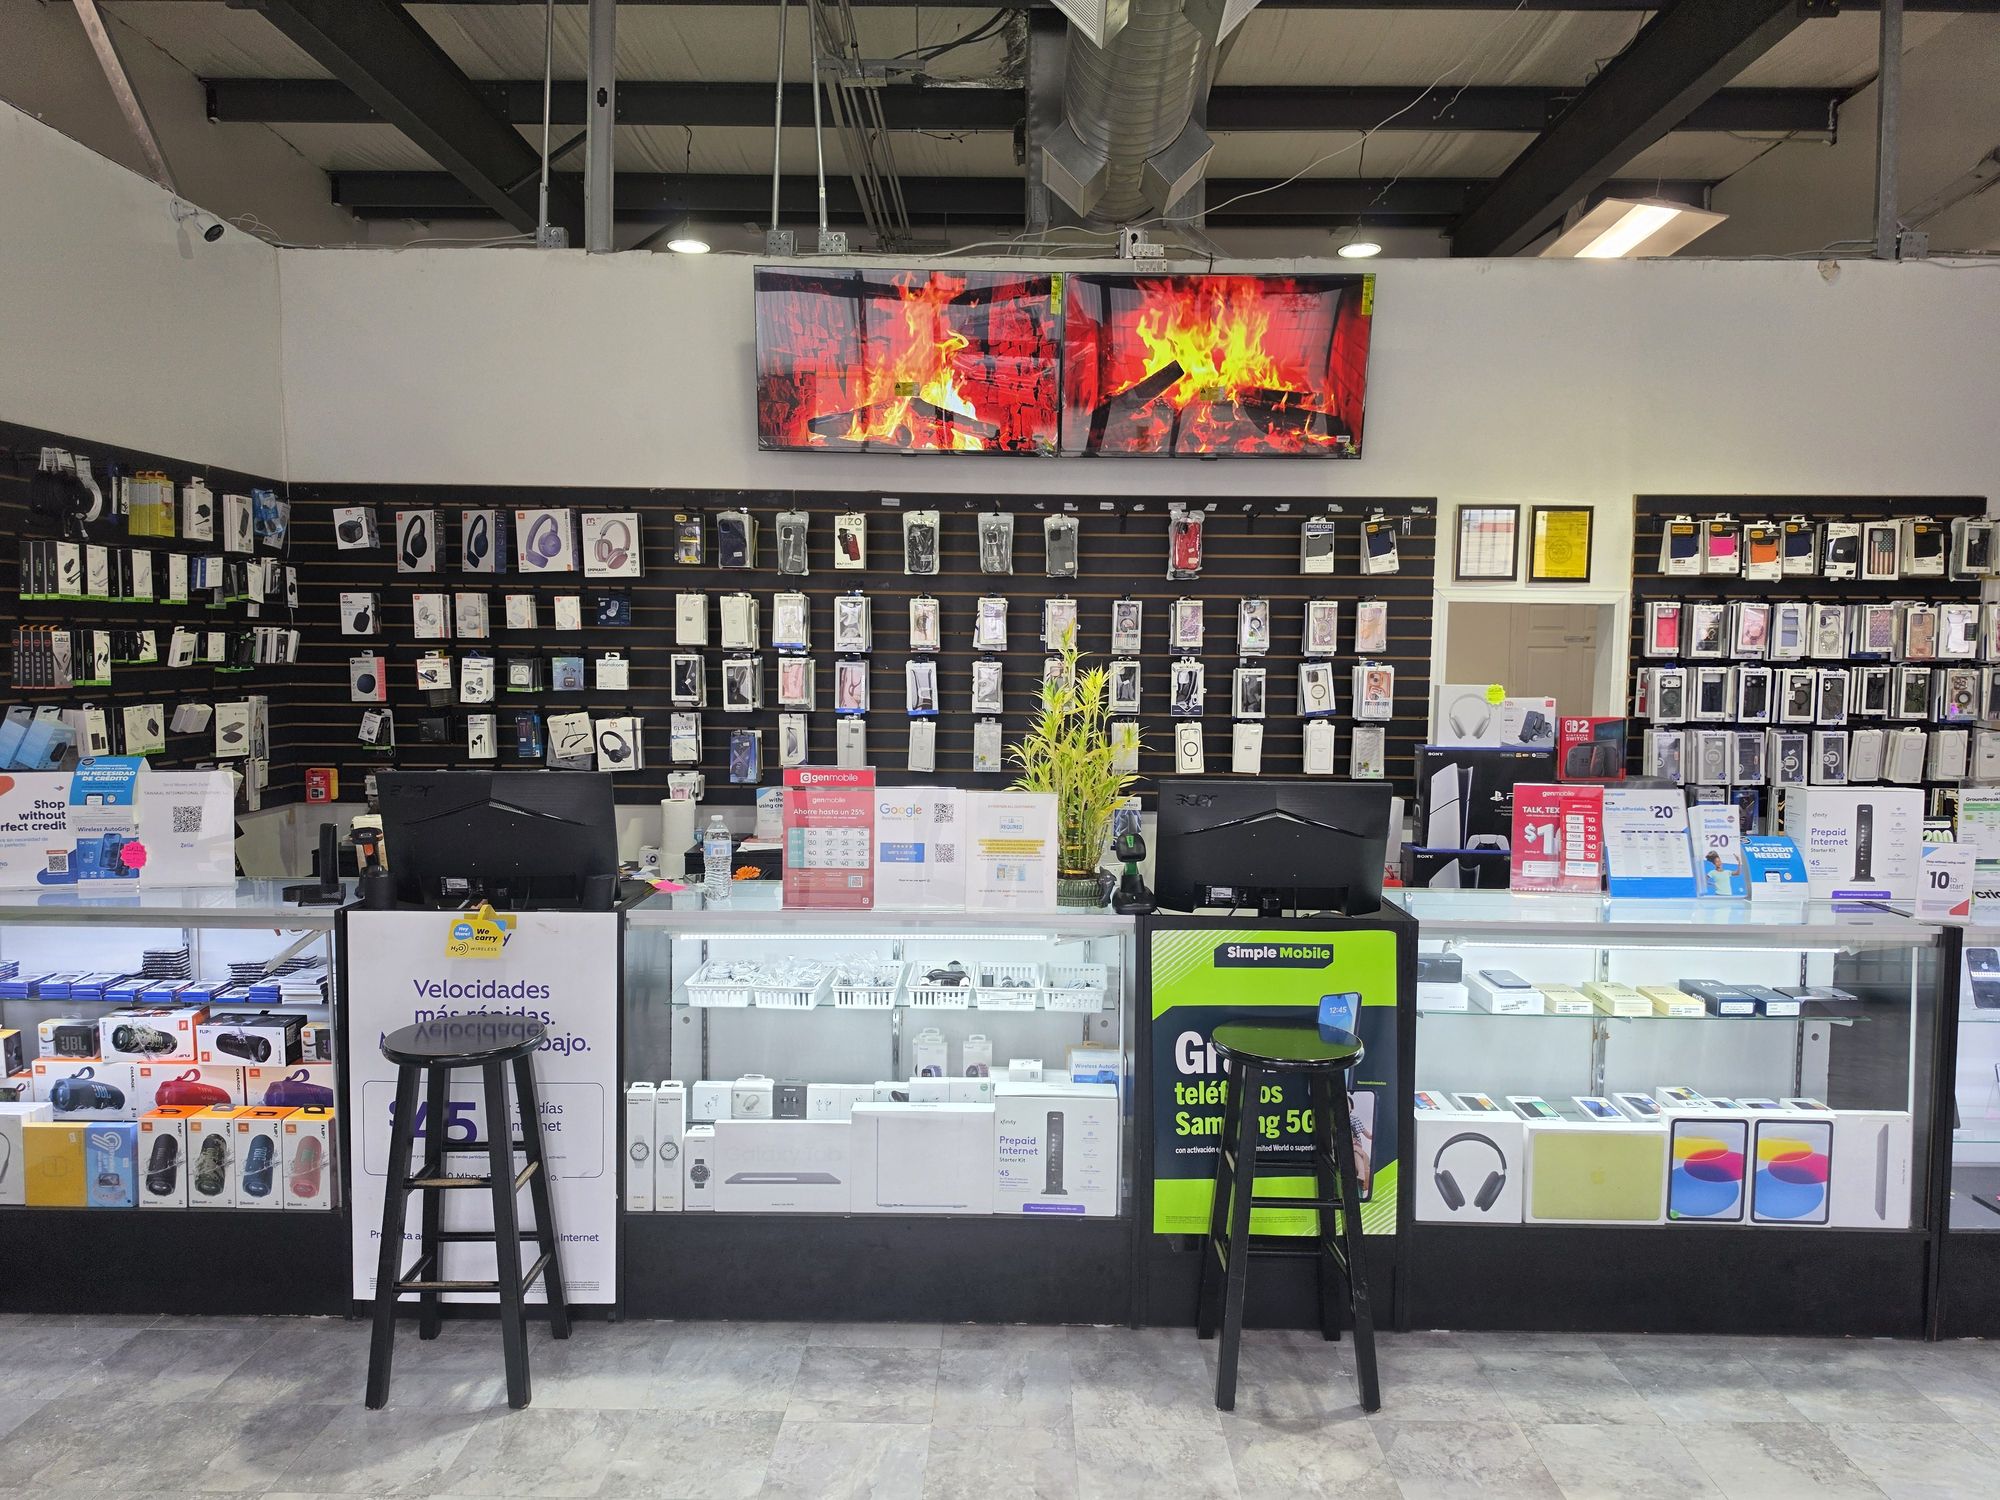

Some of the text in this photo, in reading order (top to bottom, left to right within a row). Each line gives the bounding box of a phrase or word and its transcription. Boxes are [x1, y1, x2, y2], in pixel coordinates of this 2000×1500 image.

[838, 518, 862, 526] ZIZO
[812, 773, 858, 783] genmobile
[34, 800, 66, 812] Shop
[880, 802, 922, 817] Google
[1522, 806, 1544, 814] TALK,
[19, 811, 66, 821] without
[794, 808, 817, 816] Ahorre
[819, 808, 839, 816] hasta
[850, 808, 865, 816] 25%
[1650, 805, 1673, 818] $20
[32, 821, 67, 831] credit
[1811, 827, 1847, 838] Prepaid
[1705, 834, 1729, 848] $20
[1811, 838, 1848, 846] Internet
[1927, 870, 1949, 889] $10
[475, 935, 498, 943] carry
[1227, 945, 1331, 961] Simple Mobile
[413, 979, 550, 999] Velocidades
[1329, 1006, 1347, 1014] 12:45
[63, 1036, 87, 1051] JBL
[1175, 1111, 1280, 1138] Samng
[999, 1135, 1036, 1147] Prepaid
[999, 1146, 1038, 1155] Internet
[1186, 1146, 1216, 1154] activación
[560, 1233, 599, 1242] Internet
